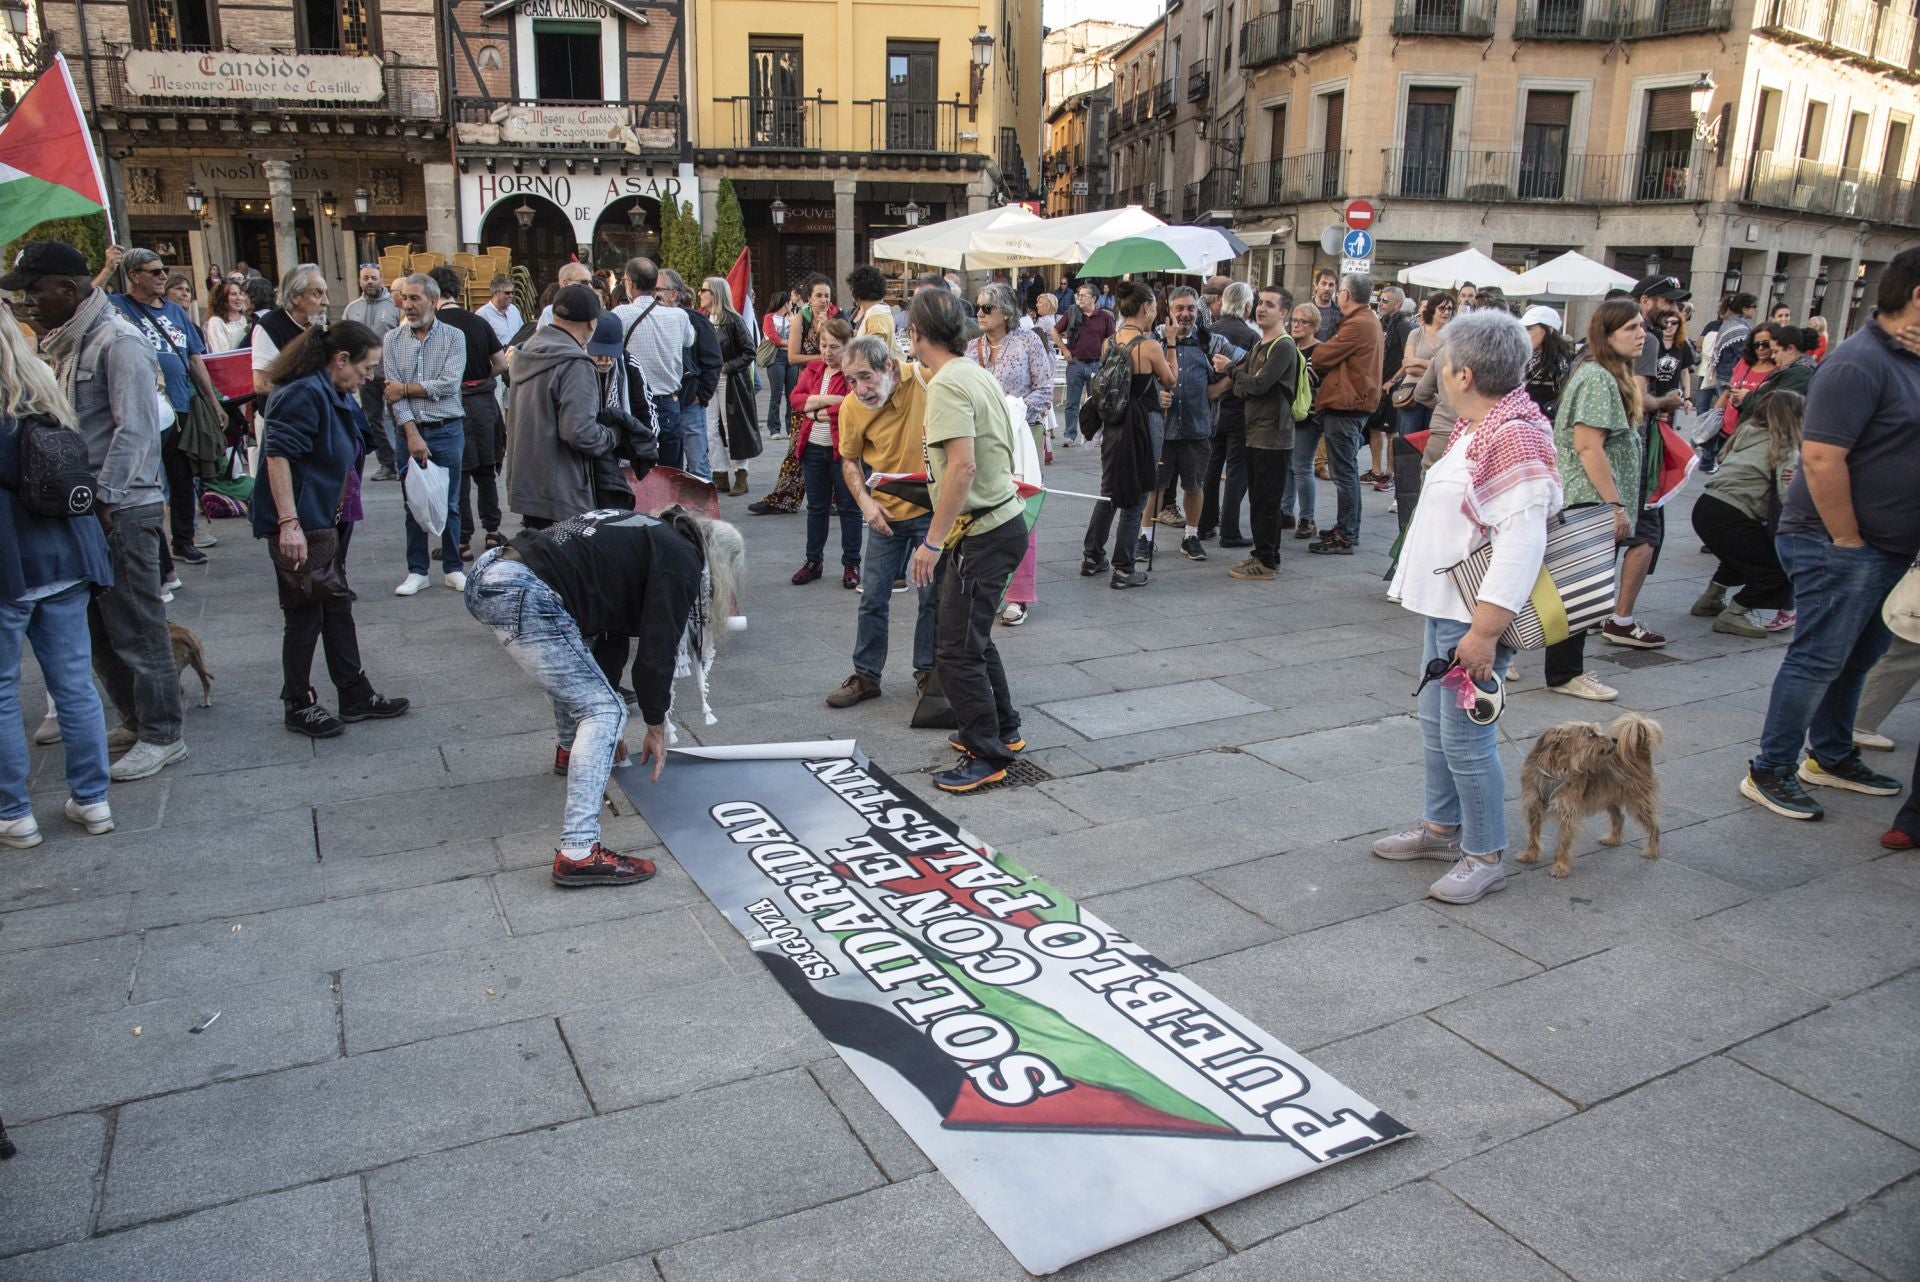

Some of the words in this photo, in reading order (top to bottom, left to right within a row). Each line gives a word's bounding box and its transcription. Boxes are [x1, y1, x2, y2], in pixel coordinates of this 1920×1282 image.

[524, 0, 553, 17] CASA
[555, 0, 608, 18] CANDIDO
[147, 74, 224, 91] Mesonero
[225, 76, 277, 96] Mayor
[284, 81, 299, 92] de
[306, 79, 361, 94] Castilla
[198, 56, 310, 78] Candido
[539, 126, 549, 137] el
[553, 125, 607, 139] Segoviano
[478, 175, 571, 215] HORNO
[575, 207, 591, 221] DE
[603, 176, 682, 217] ASAR
[825, 825, 922, 888] EL
[709, 801, 1075, 1107] SOLIDARIDAD
[745, 898, 840, 981] SEGOVIA
[880, 889, 1042, 986] CON
[1024, 920, 1385, 1163] PUEBLO
